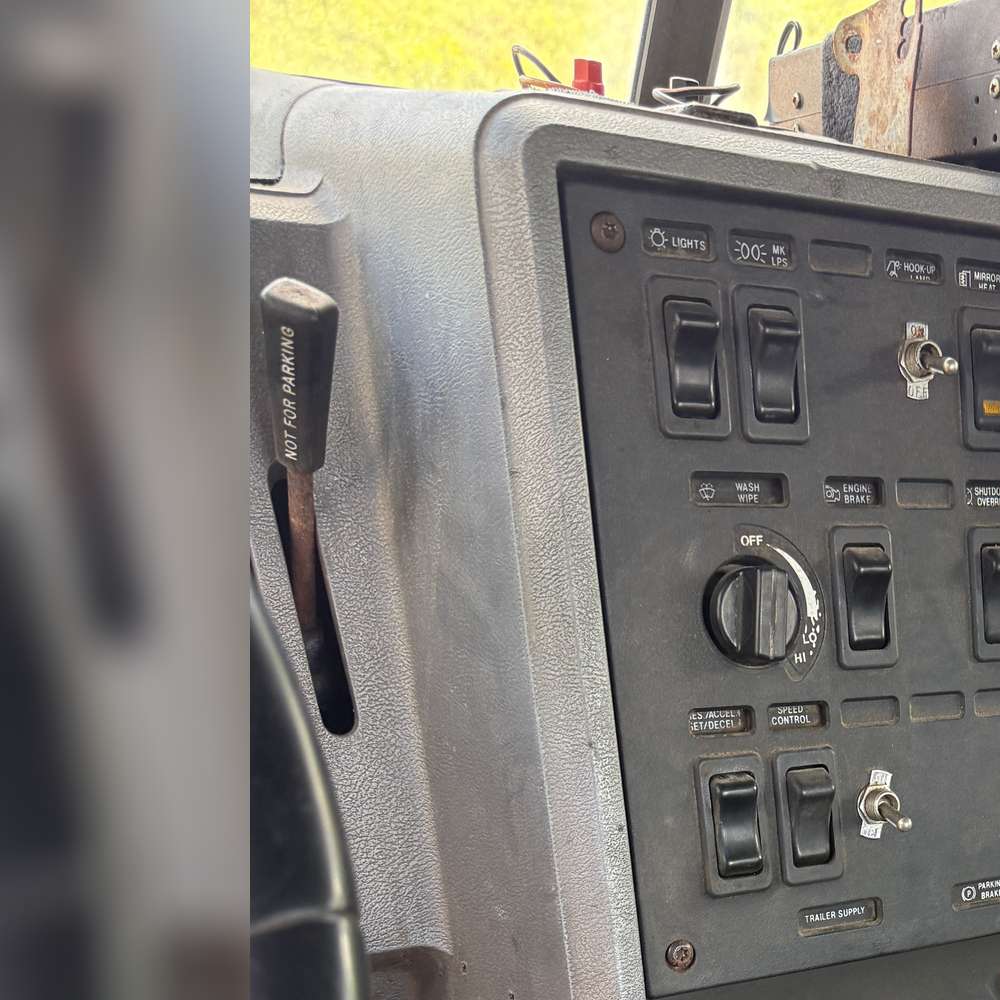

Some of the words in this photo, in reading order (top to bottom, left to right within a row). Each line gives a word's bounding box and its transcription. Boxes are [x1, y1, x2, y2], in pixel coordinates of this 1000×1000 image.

[672, 237, 706, 251] LIGHTS
[772, 245, 785, 256] MK
[771, 257, 788, 268] LPS
[903, 262, 936, 274] HOOK-UP
[974, 271, 1000, 283] MIRROR
[281, 325, 296, 396] PARKING
[284, 399, 297, 429] FOR
[285, 432, 298, 461] NOT
[735, 483, 760, 493] WASH
[843, 484, 872, 493] ENGINE
[738, 494, 760, 504] WIPE
[844, 494, 871, 504] BRAKE
[740, 535, 763, 546] OFF
[803, 632, 817, 645] LO
[794, 653, 807, 664] HI
[778, 705, 804, 715] SPEED
[771, 715, 811, 726] CONTROL
[804, 911, 836, 924] TRAILER
[838, 906, 865, 919] SUPPLY
